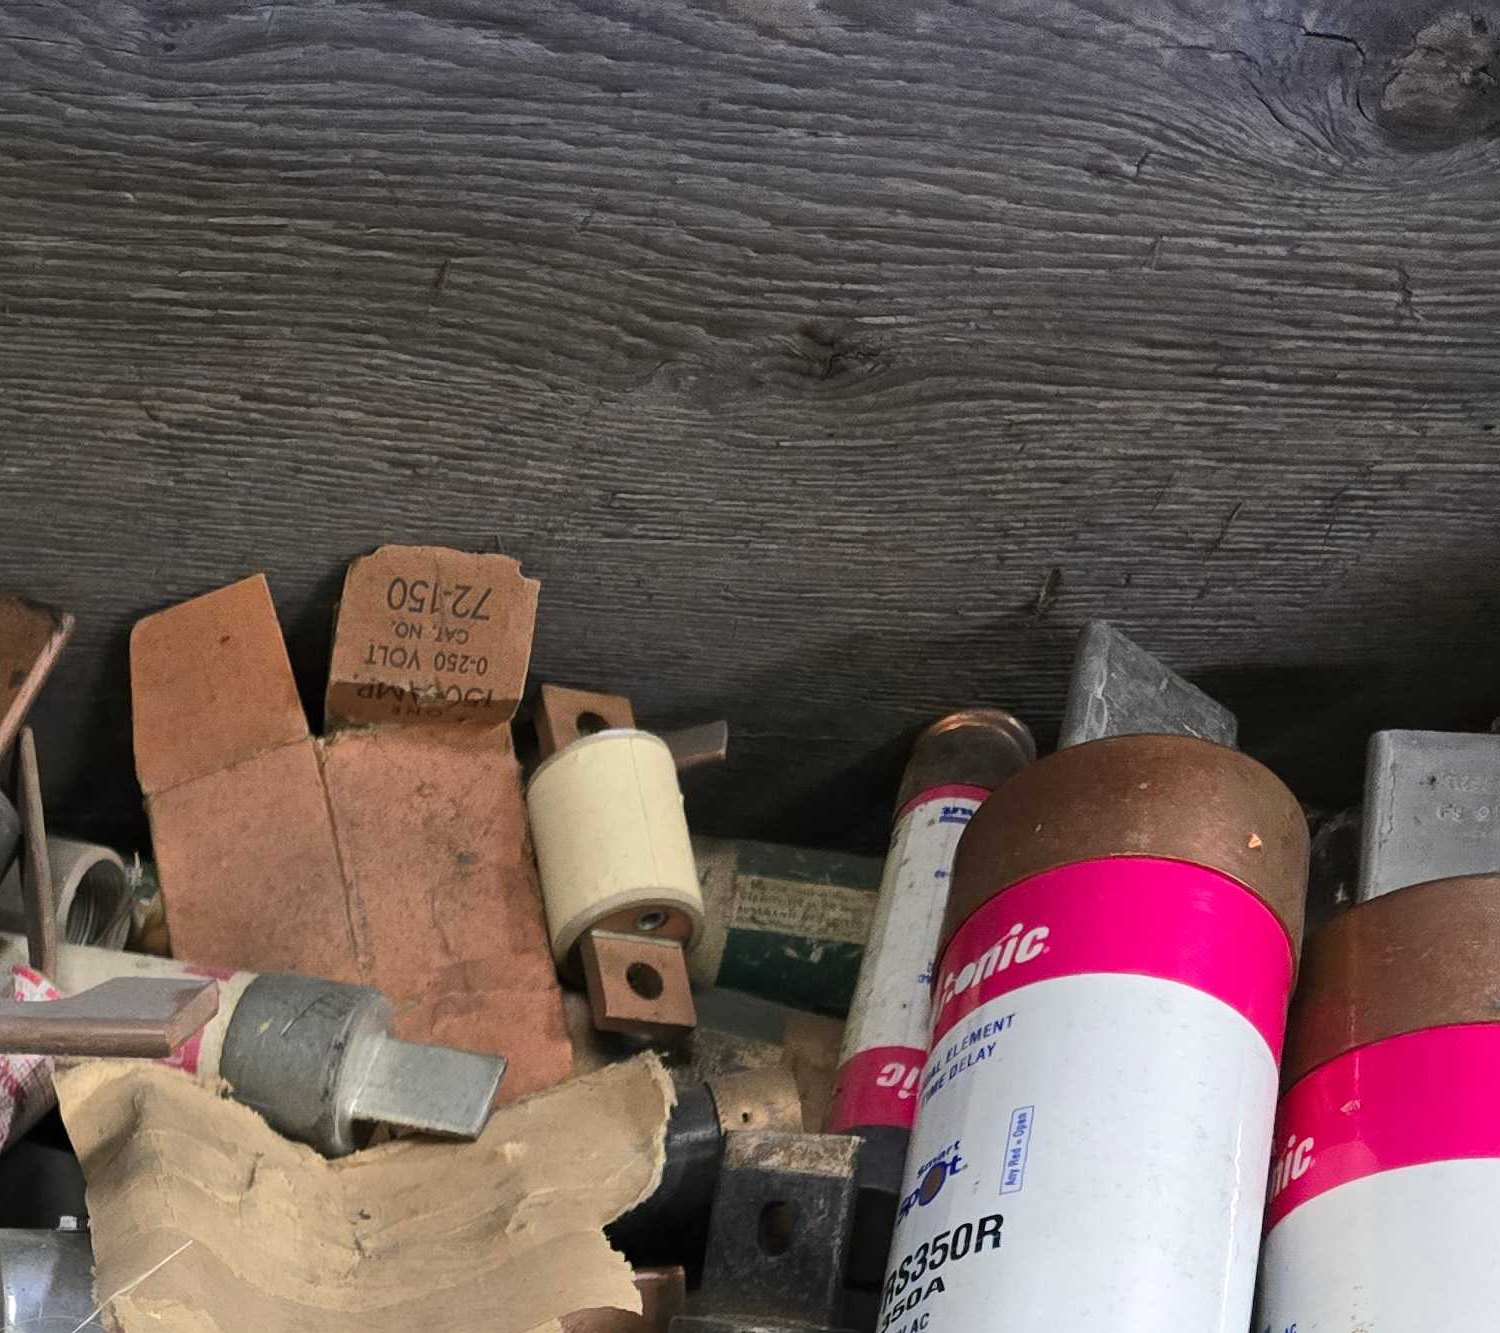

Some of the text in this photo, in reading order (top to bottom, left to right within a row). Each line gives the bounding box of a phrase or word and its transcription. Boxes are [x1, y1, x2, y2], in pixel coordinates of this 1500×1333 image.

[387, 577, 493, 621] 72-150
[392, 620, 470, 645] CAT. NO.
[364, 644, 488, 676] 0-250 VOLT
[946, 1013, 1017, 1061] ELEMENT
[948, 1042, 997, 1081] DELAY
